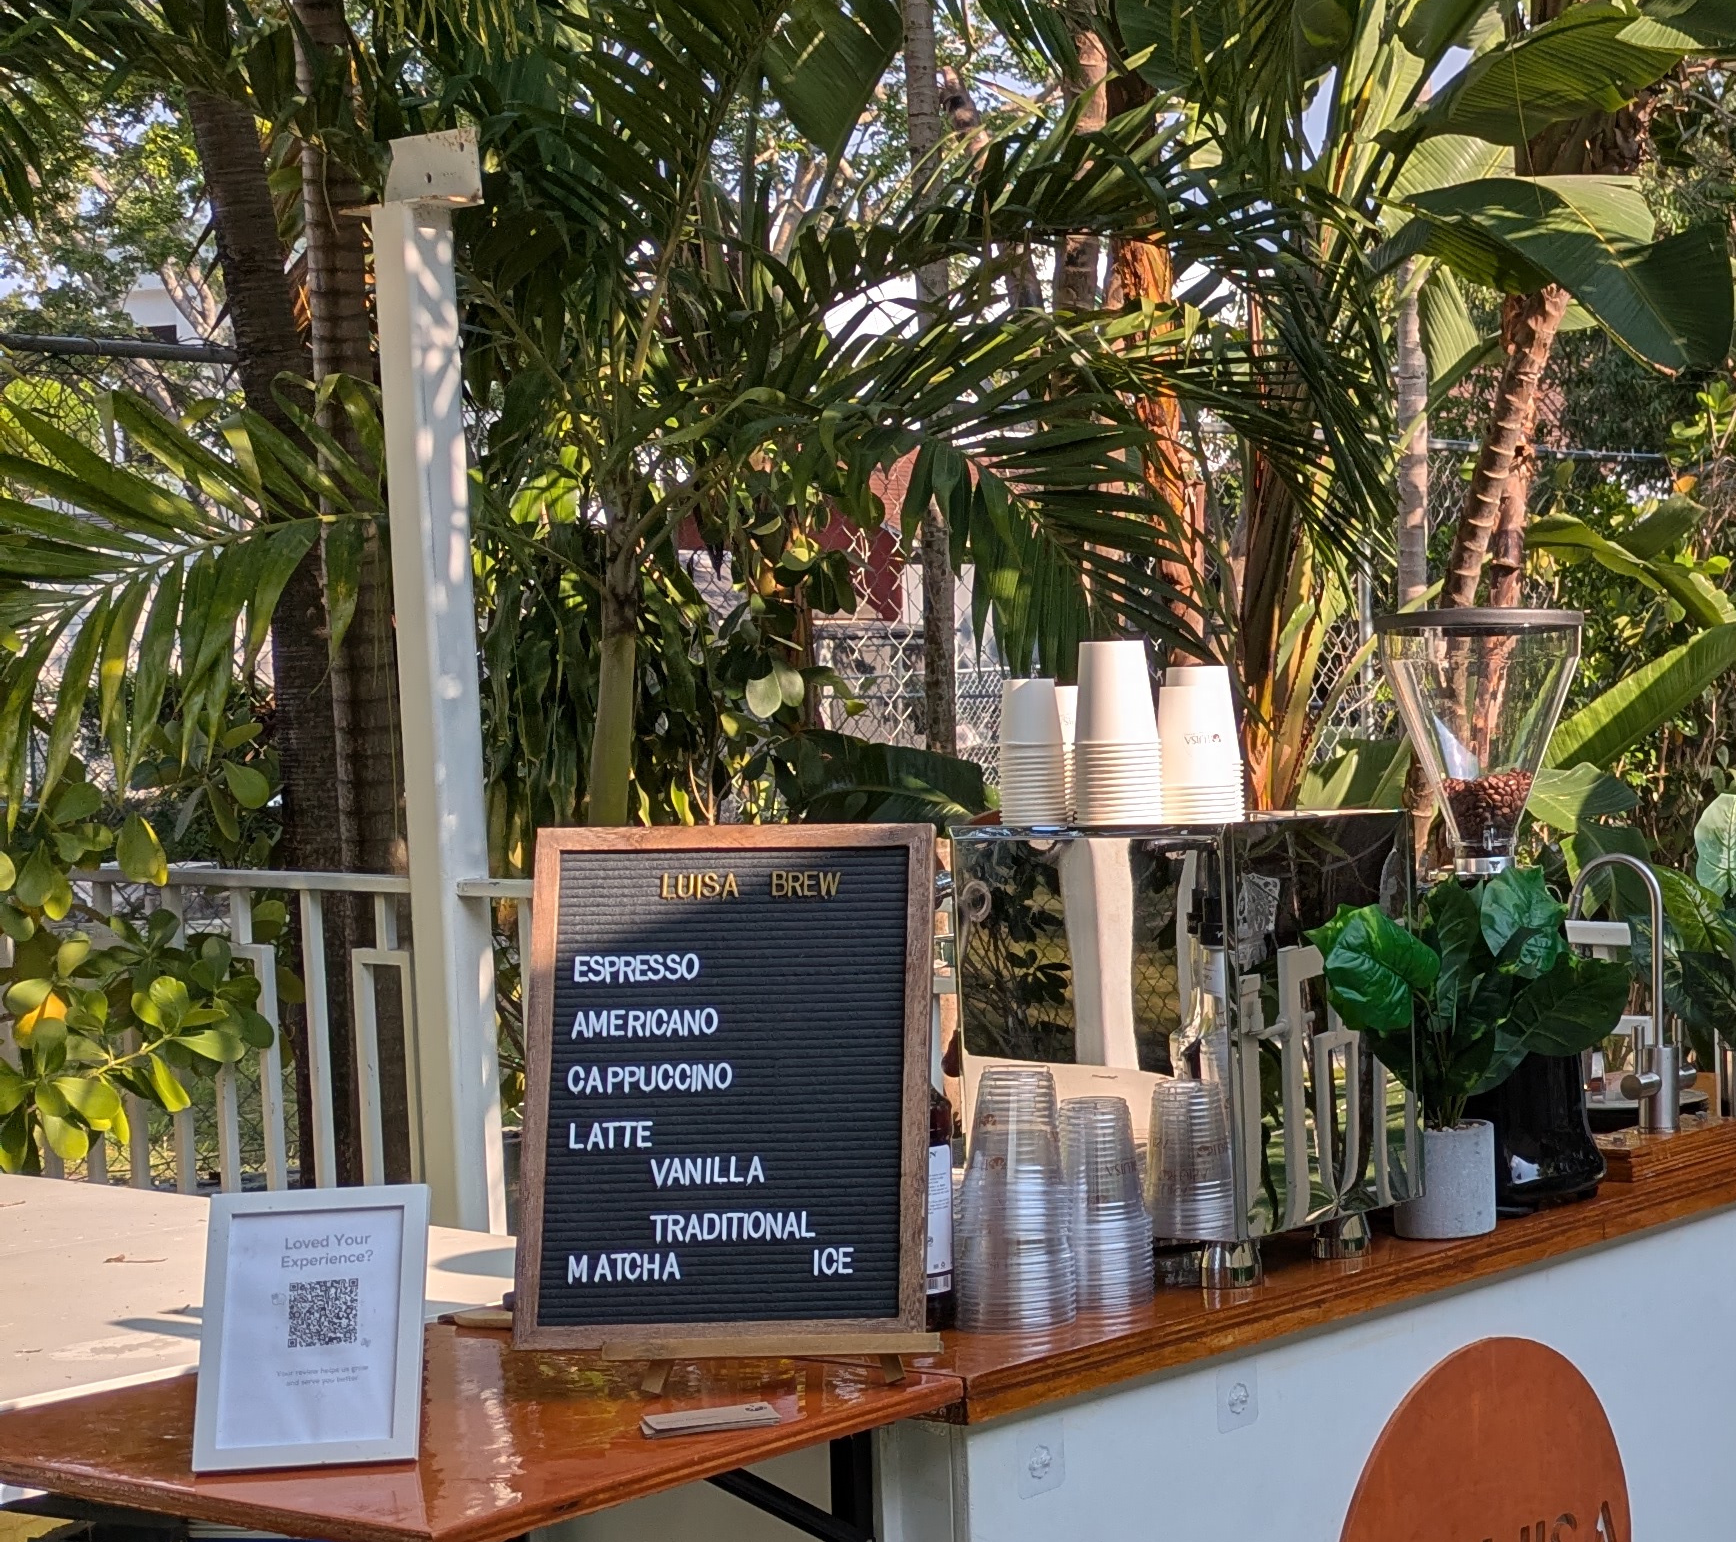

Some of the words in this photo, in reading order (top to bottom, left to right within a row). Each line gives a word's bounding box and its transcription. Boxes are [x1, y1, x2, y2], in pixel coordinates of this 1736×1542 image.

[661, 872, 739, 900] LUISA
[771, 870, 841, 897] BREW
[574, 954, 699, 983] ESPRESSO
[572, 1008, 718, 1039] AMERICANO
[568, 1063, 732, 1094] CAPPUCCINO
[570, 1121, 653, 1150] LATTE
[651, 1156, 764, 1187] VANILLA
[284, 1235, 330, 1251] Loved
[333, 1232, 372, 1247] Your
[650, 1211, 815, 1243] TRADITIONAL
[280, 1249, 374, 1270] Experience?
[568, 1252, 680, 1284] MATCHA
[814, 1248, 853, 1275] ICE
